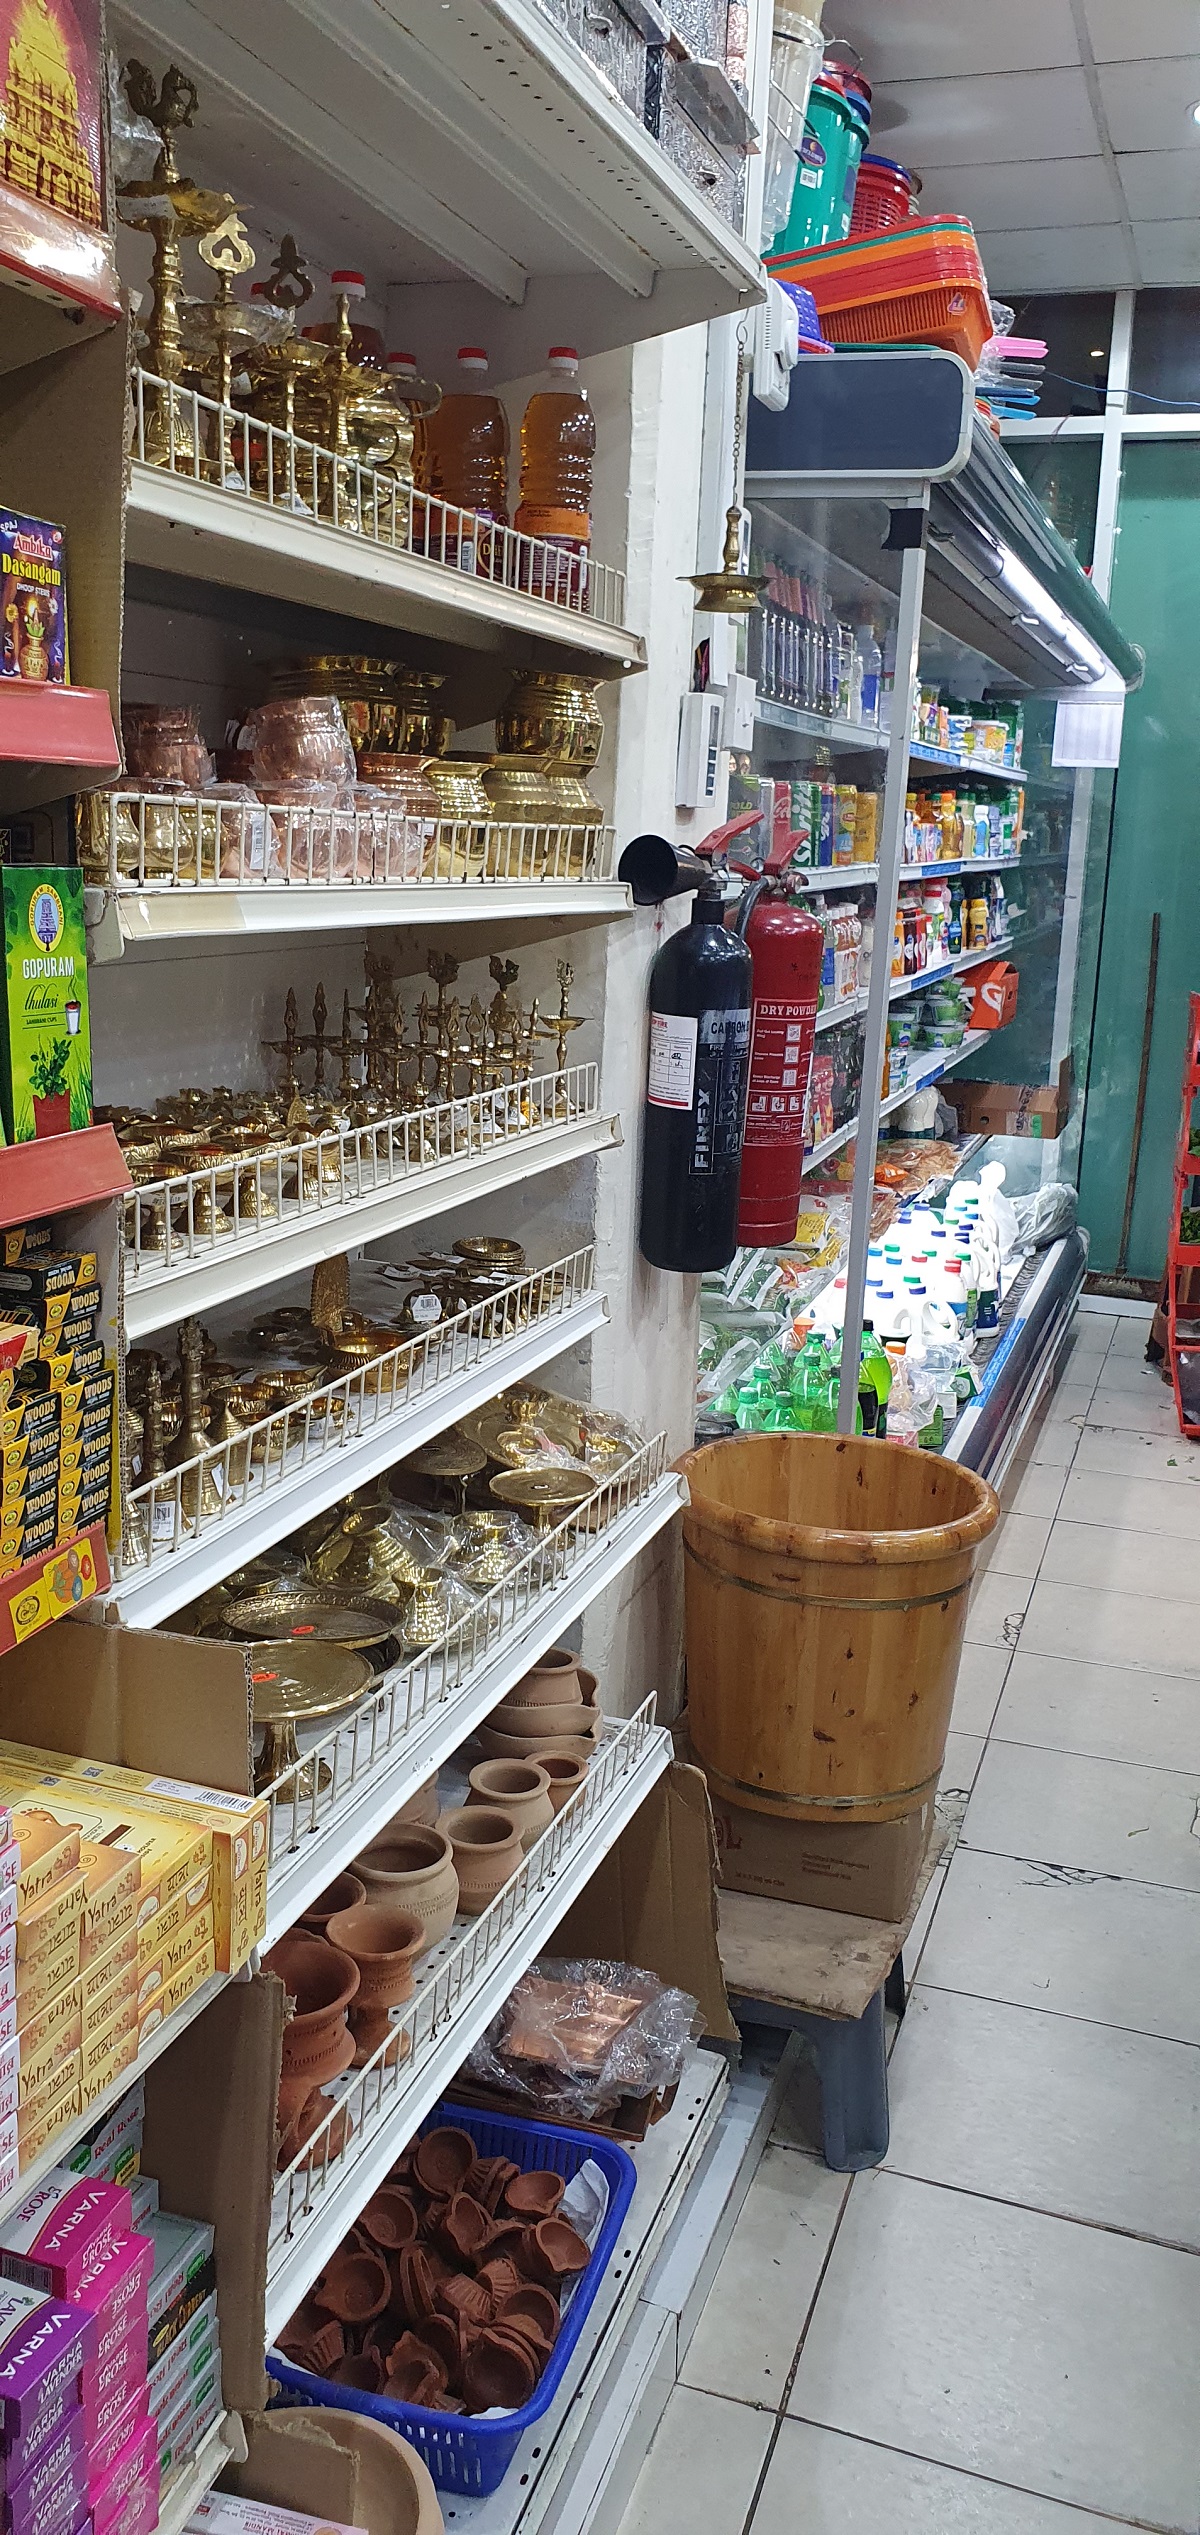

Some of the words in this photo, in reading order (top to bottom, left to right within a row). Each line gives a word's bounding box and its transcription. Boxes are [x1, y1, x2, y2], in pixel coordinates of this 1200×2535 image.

[13, 531, 53, 561] Ambika
[2, 553, 61, 587] Dasangam
[22, 956, 75, 980] GOPURAM
[24, 983, 59, 1010] thulasi
[760, 1004, 785, 1016] DRY
[786, 1004, 817, 1016] POWDE
[45, 1270, 76, 1292] WOODS
[71, 1289, 100, 1312] WOODS
[64, 1317, 92, 1340] WOODS
[73, 1346, 103, 1372] WOODS
[84, 1375, 113, 1400] WOODS
[25, 1397, 57, 1424] WOODS
[83, 1403, 112, 1429] WOODS
[29, 1428, 60, 1455] WOODS
[83, 1431, 111, 1457] WOODS
[28, 1457, 59, 1485] WOODS
[82, 1459, 110, 1483] WOODS
[26, 1486, 57, 1515] WOODS
[82, 1486, 110, 1512] WOODS
[24, 1514, 55, 1543] WOODS
[20, 1867, 53, 1905] Yatra
[57, 1879, 89, 1916] Yatra
[254, 1860, 266, 1907] Yatra
[88, 1893, 117, 1928] Yatra
[167, 1938, 192, 1971] Yatra
[48, 1986, 78, 2024] Yatra
[168, 1975, 194, 2007] Yatra
[21, 2056, 54, 2096] Yatra
[83, 2068, 113, 2108] Yatra
[47, 2092, 78, 2133] Yatra
[16, 2190, 51, 2223] ROSE
[44, 2191, 107, 2250] VARNA
[0, 2313, 71, 2379] VARNA
[39, 2350, 82, 2403] LAVENDER
[42, 2341, 83, 2387] VARNA
[26, 2395, 63, 2444] VARNA
[33, 2434, 71, 2484] VARNA
[36, 2472, 73, 2520] VARNA
